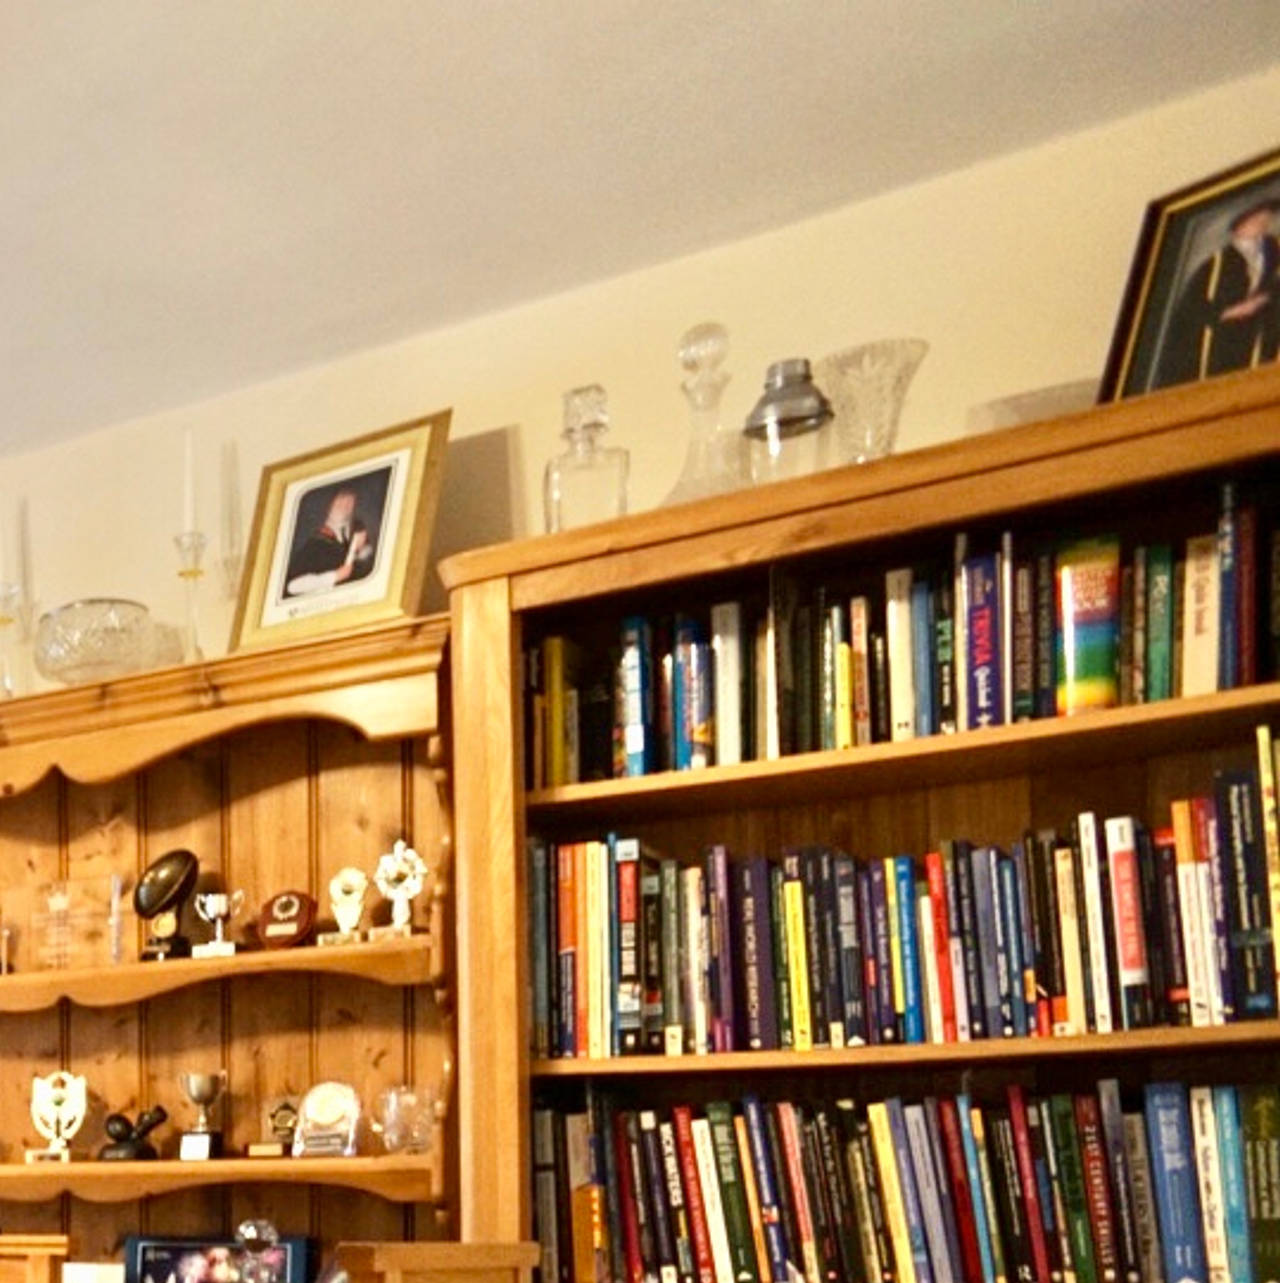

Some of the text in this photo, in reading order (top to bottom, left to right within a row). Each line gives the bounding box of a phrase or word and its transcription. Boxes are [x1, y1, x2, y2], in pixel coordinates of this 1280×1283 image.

[974, 607, 991, 666] TRIVIA
[743, 922, 757, 963] WORLD
[745, 964, 760, 1018] RESEARCH
[664, 1154, 684, 1207] WATERS
[1084, 1124, 1114, 1266] 21ST CENTURY SKILLS
